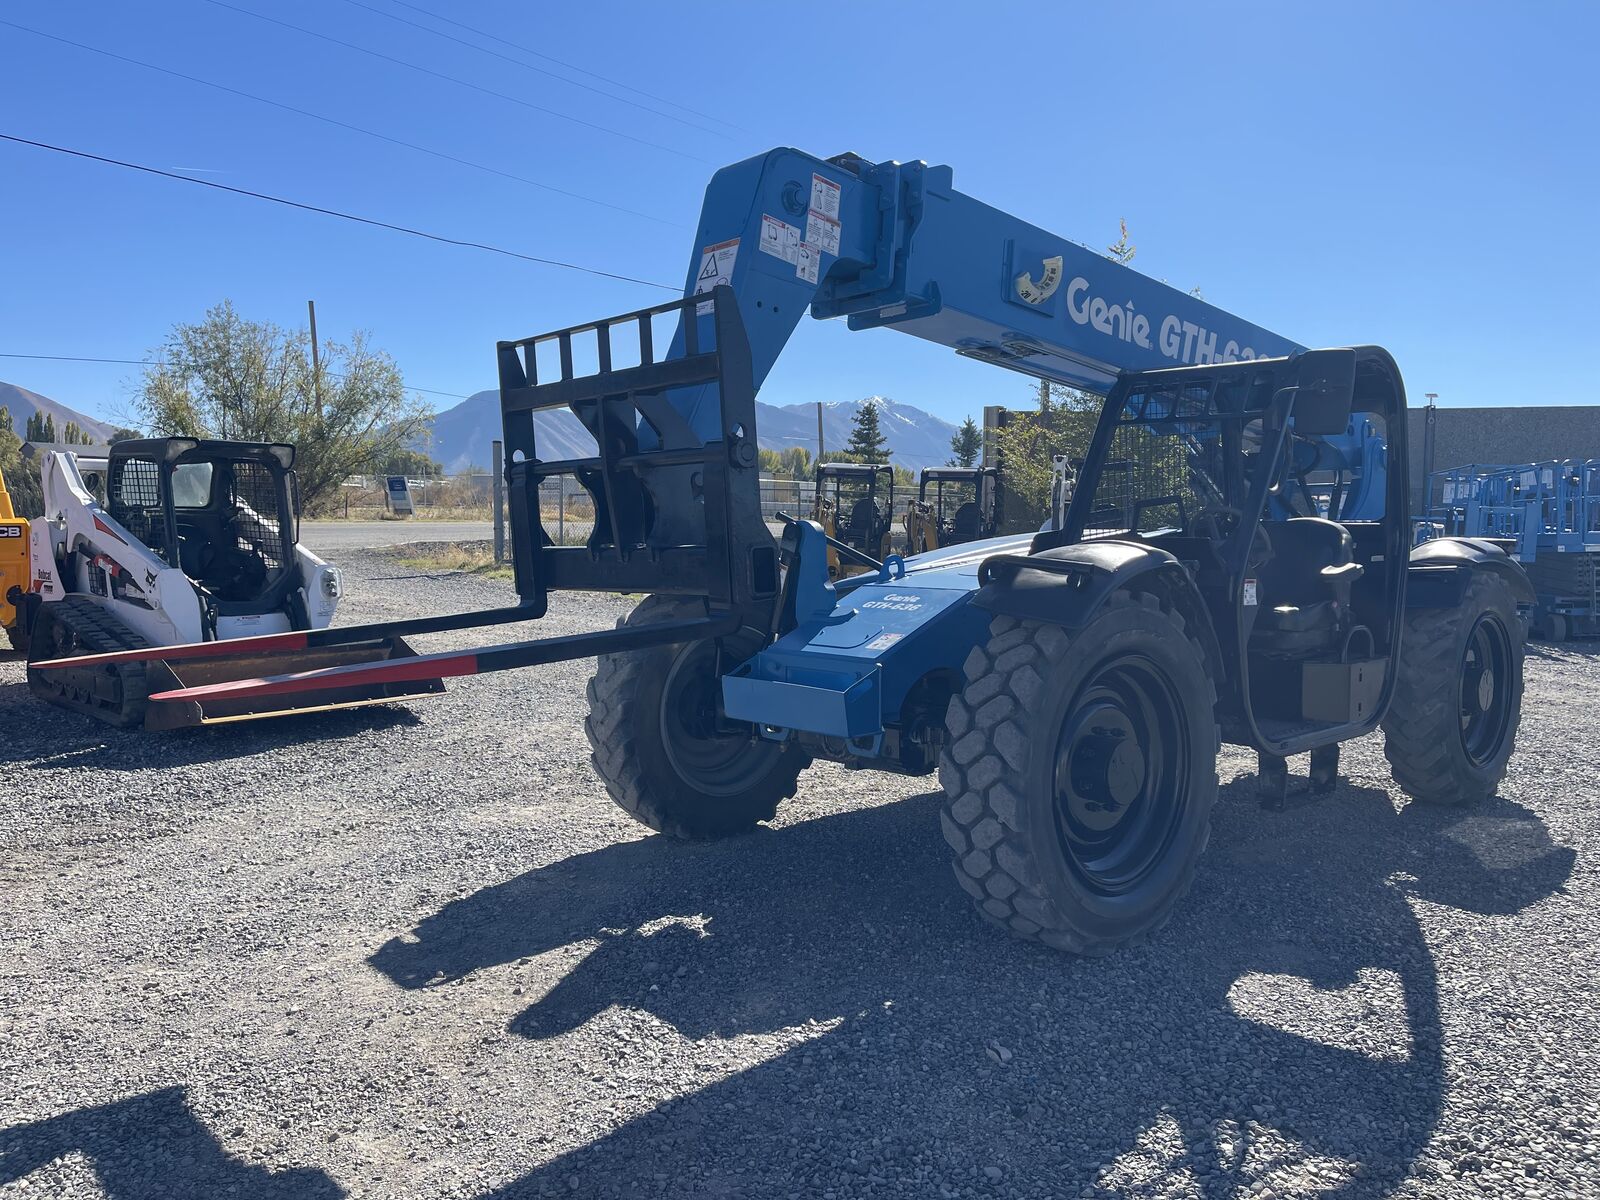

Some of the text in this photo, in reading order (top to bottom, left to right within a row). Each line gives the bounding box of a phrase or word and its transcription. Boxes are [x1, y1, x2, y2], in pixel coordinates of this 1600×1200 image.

[1066, 276, 1270, 365] Genie GTH-6
[0, 526, 21, 538] CB
[883, 593, 921, 603] Genie
[862, 601, 922, 611] GTH-636
